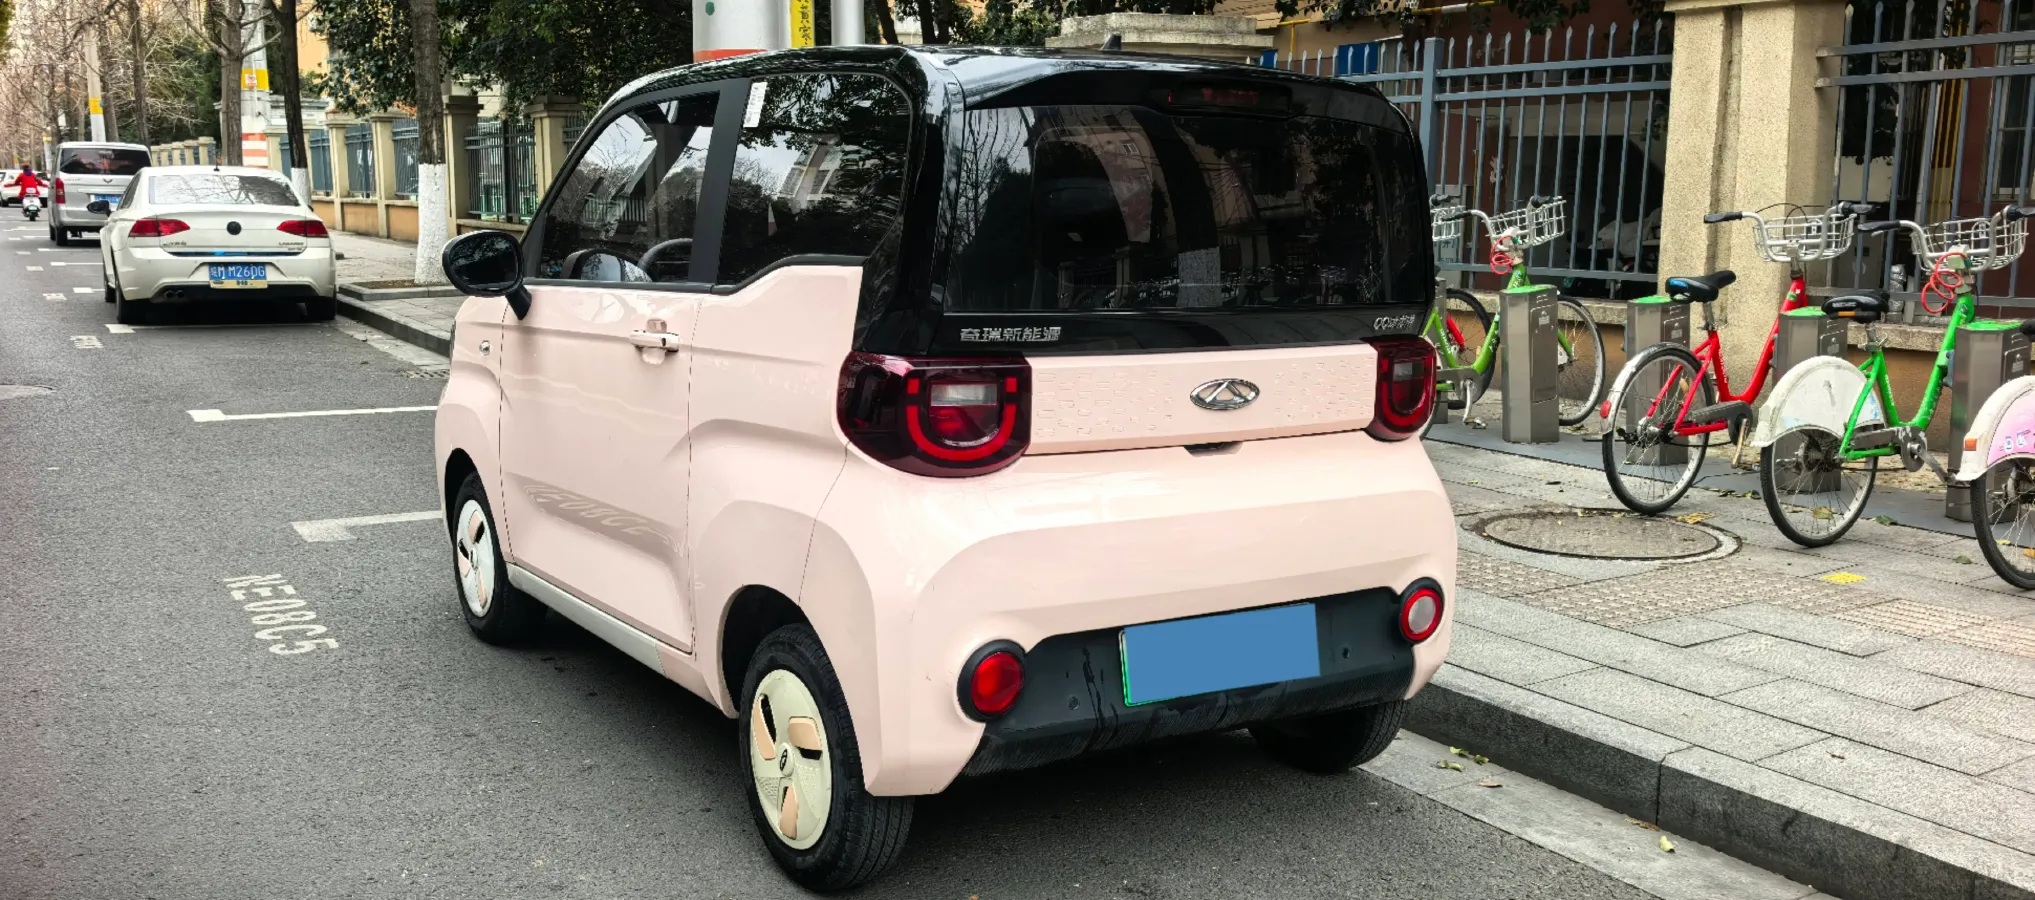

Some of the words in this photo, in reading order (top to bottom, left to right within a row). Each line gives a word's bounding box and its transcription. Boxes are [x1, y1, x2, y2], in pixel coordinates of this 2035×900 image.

[960, 326, 1062, 343] 奇瑞新能源
[223, 573, 340, 655] NE08C5
